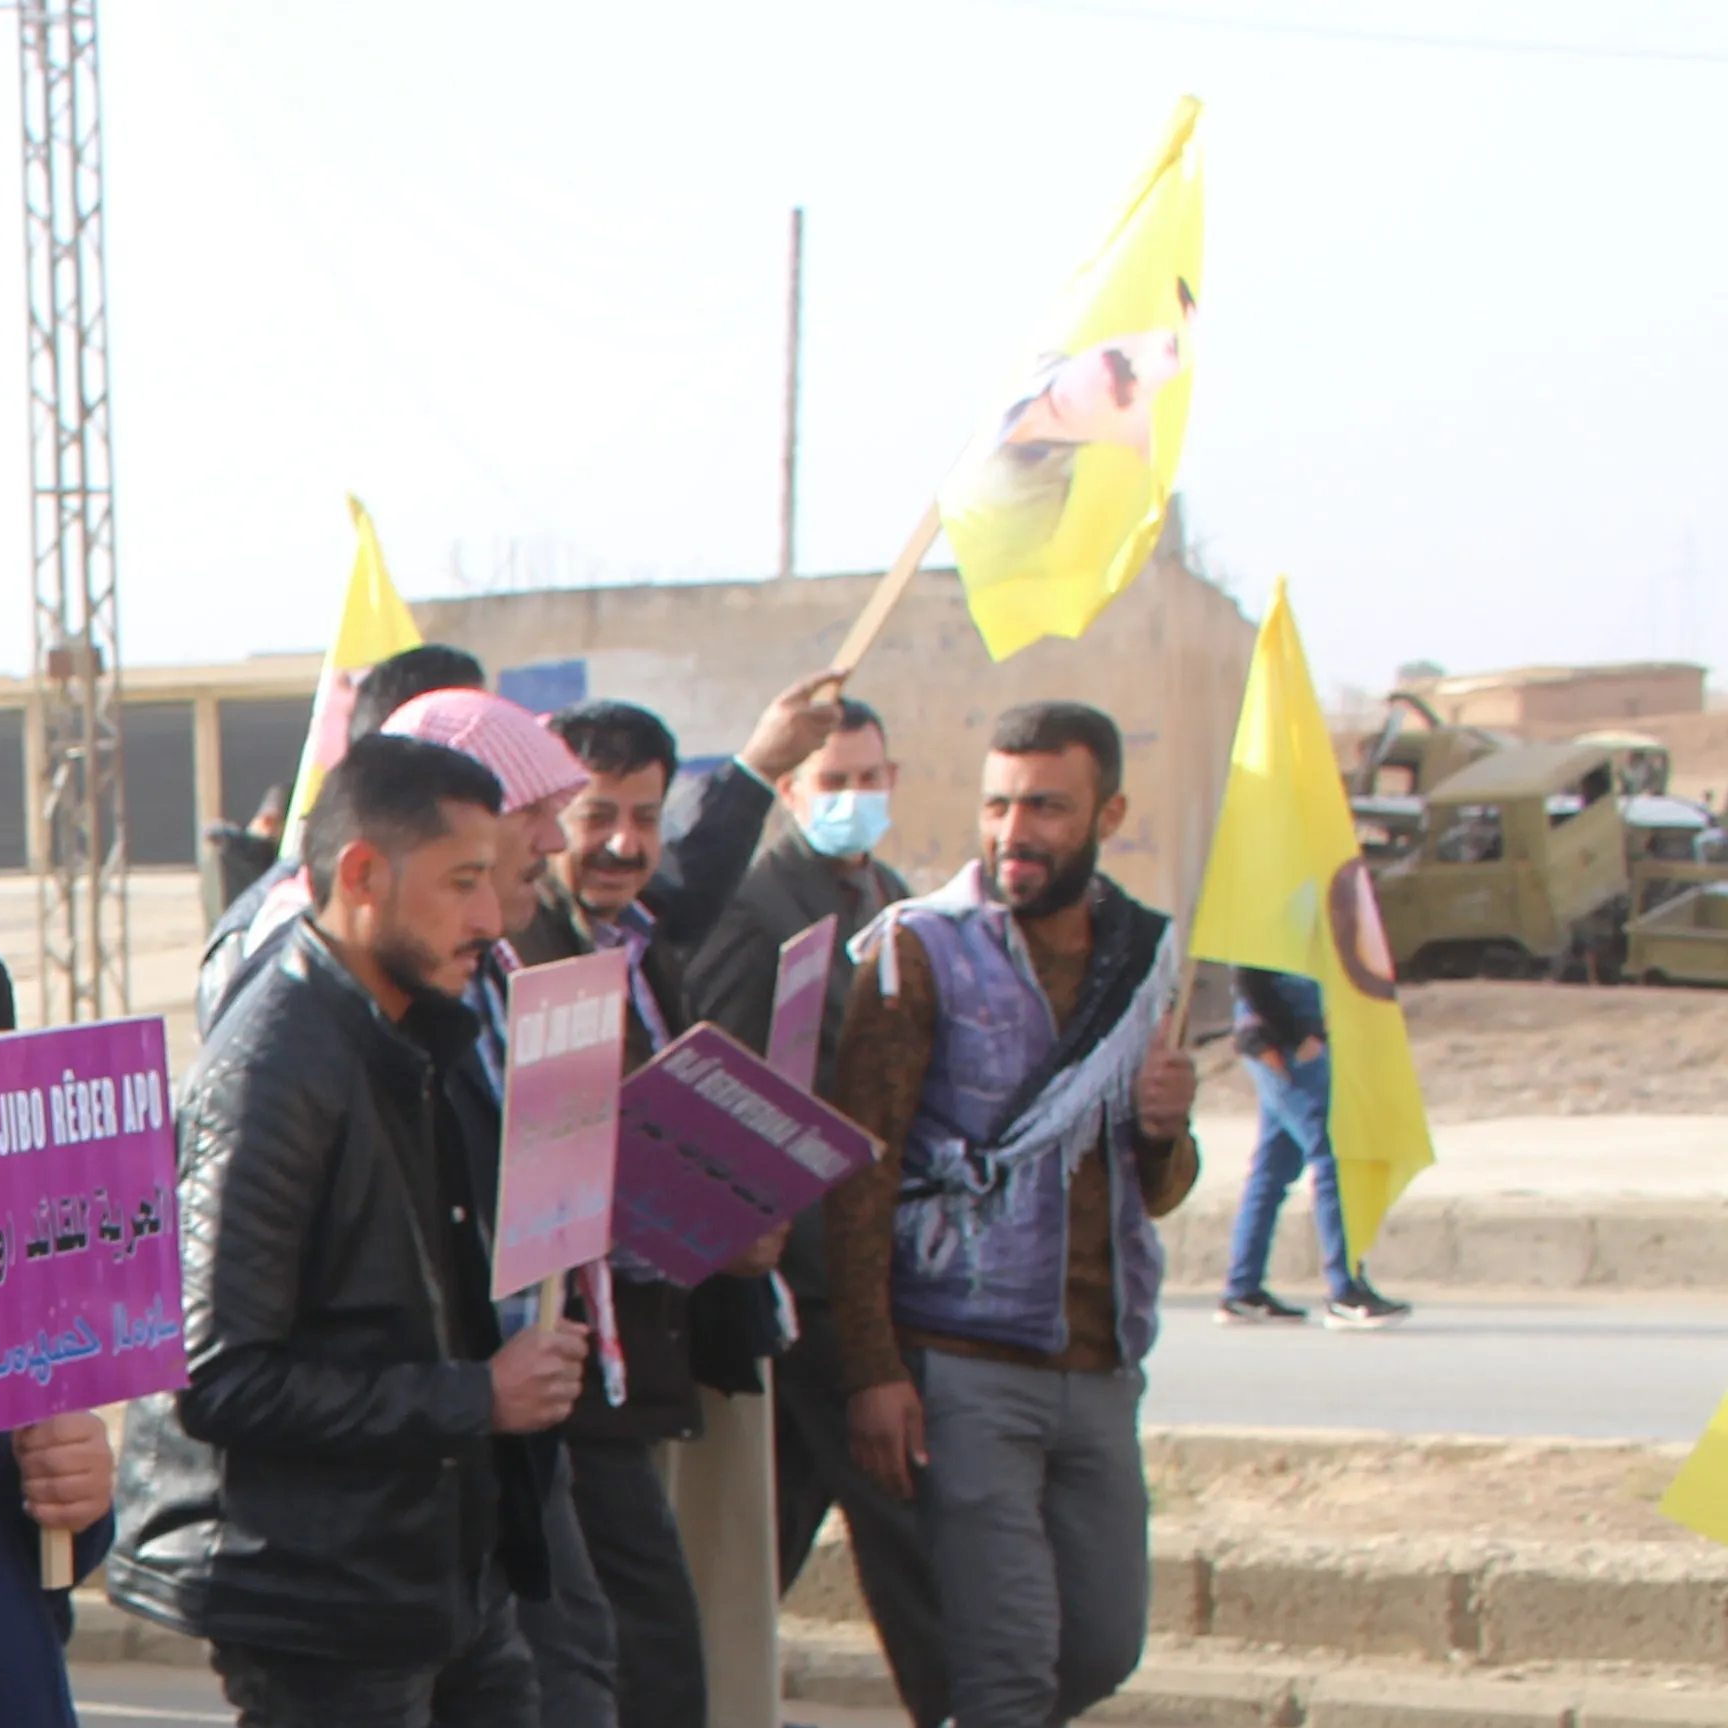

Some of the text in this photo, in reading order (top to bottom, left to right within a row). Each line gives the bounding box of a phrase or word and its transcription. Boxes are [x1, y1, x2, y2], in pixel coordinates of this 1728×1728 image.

[49, 1068, 118, 1147] RÊBER
[122, 1070, 164, 1133] APO
[25, 1194, 95, 1263] للقائد
[98, 1181, 173, 1264] الحرية
